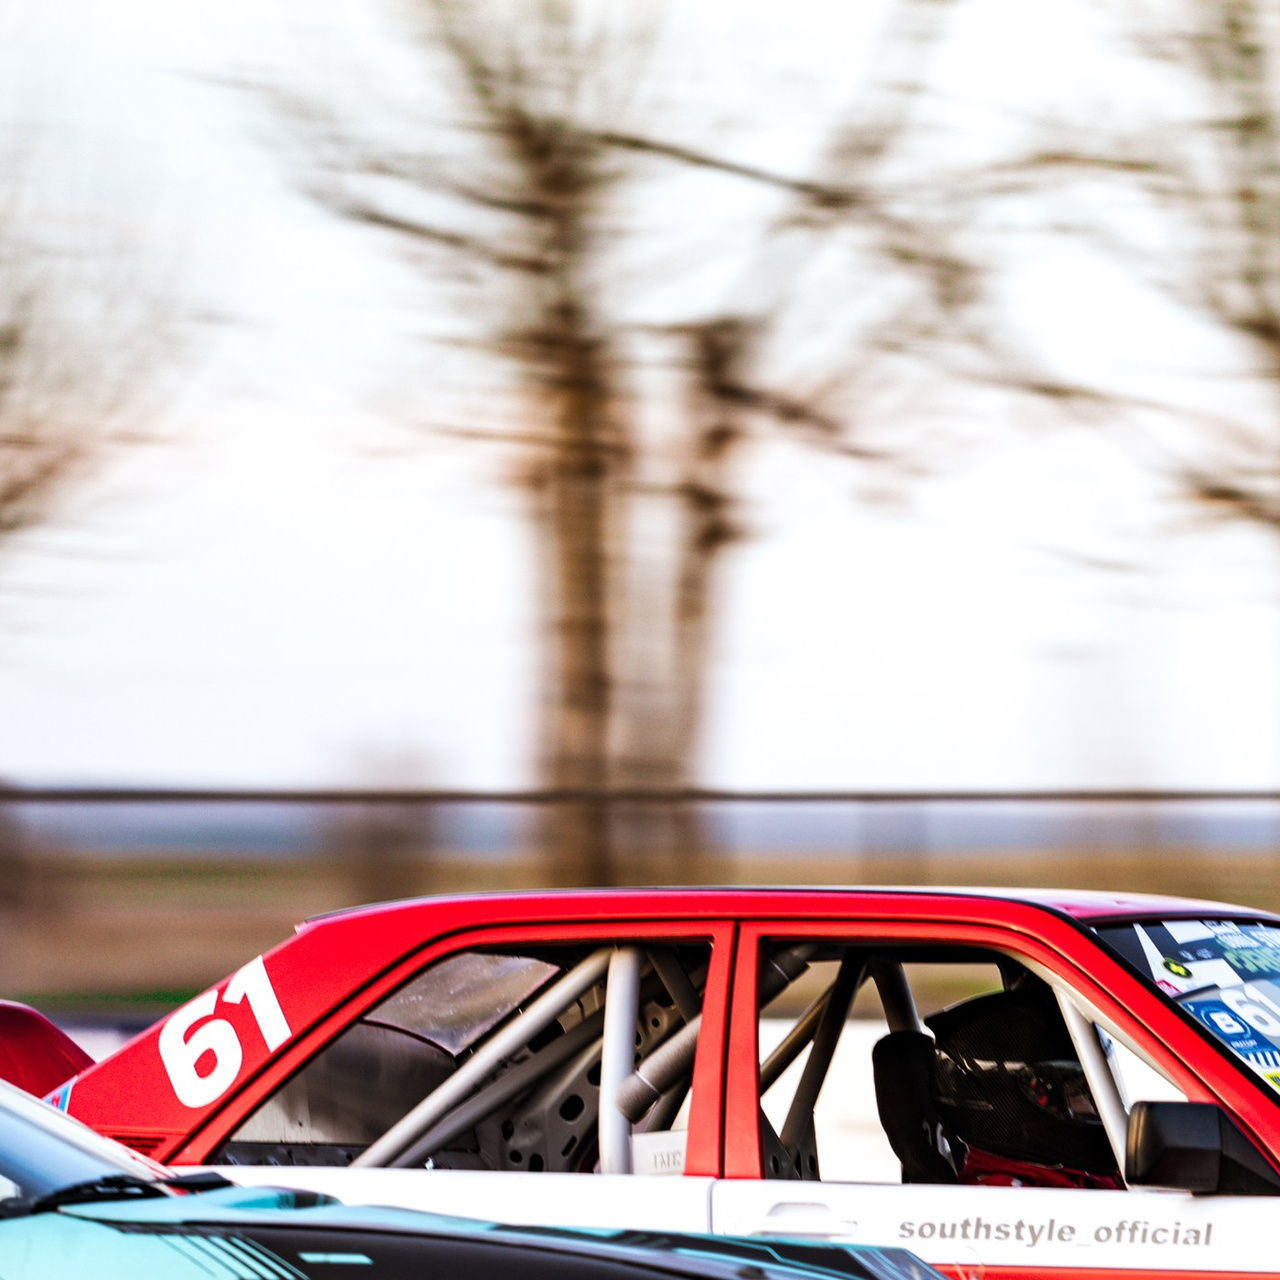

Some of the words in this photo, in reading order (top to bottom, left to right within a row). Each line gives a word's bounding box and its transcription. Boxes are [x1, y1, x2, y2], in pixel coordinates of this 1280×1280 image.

[158, 954, 293, 1109] 61
[1209, 1012, 1245, 1034] B
[898, 1217, 1213, 1248] southstyle_official
